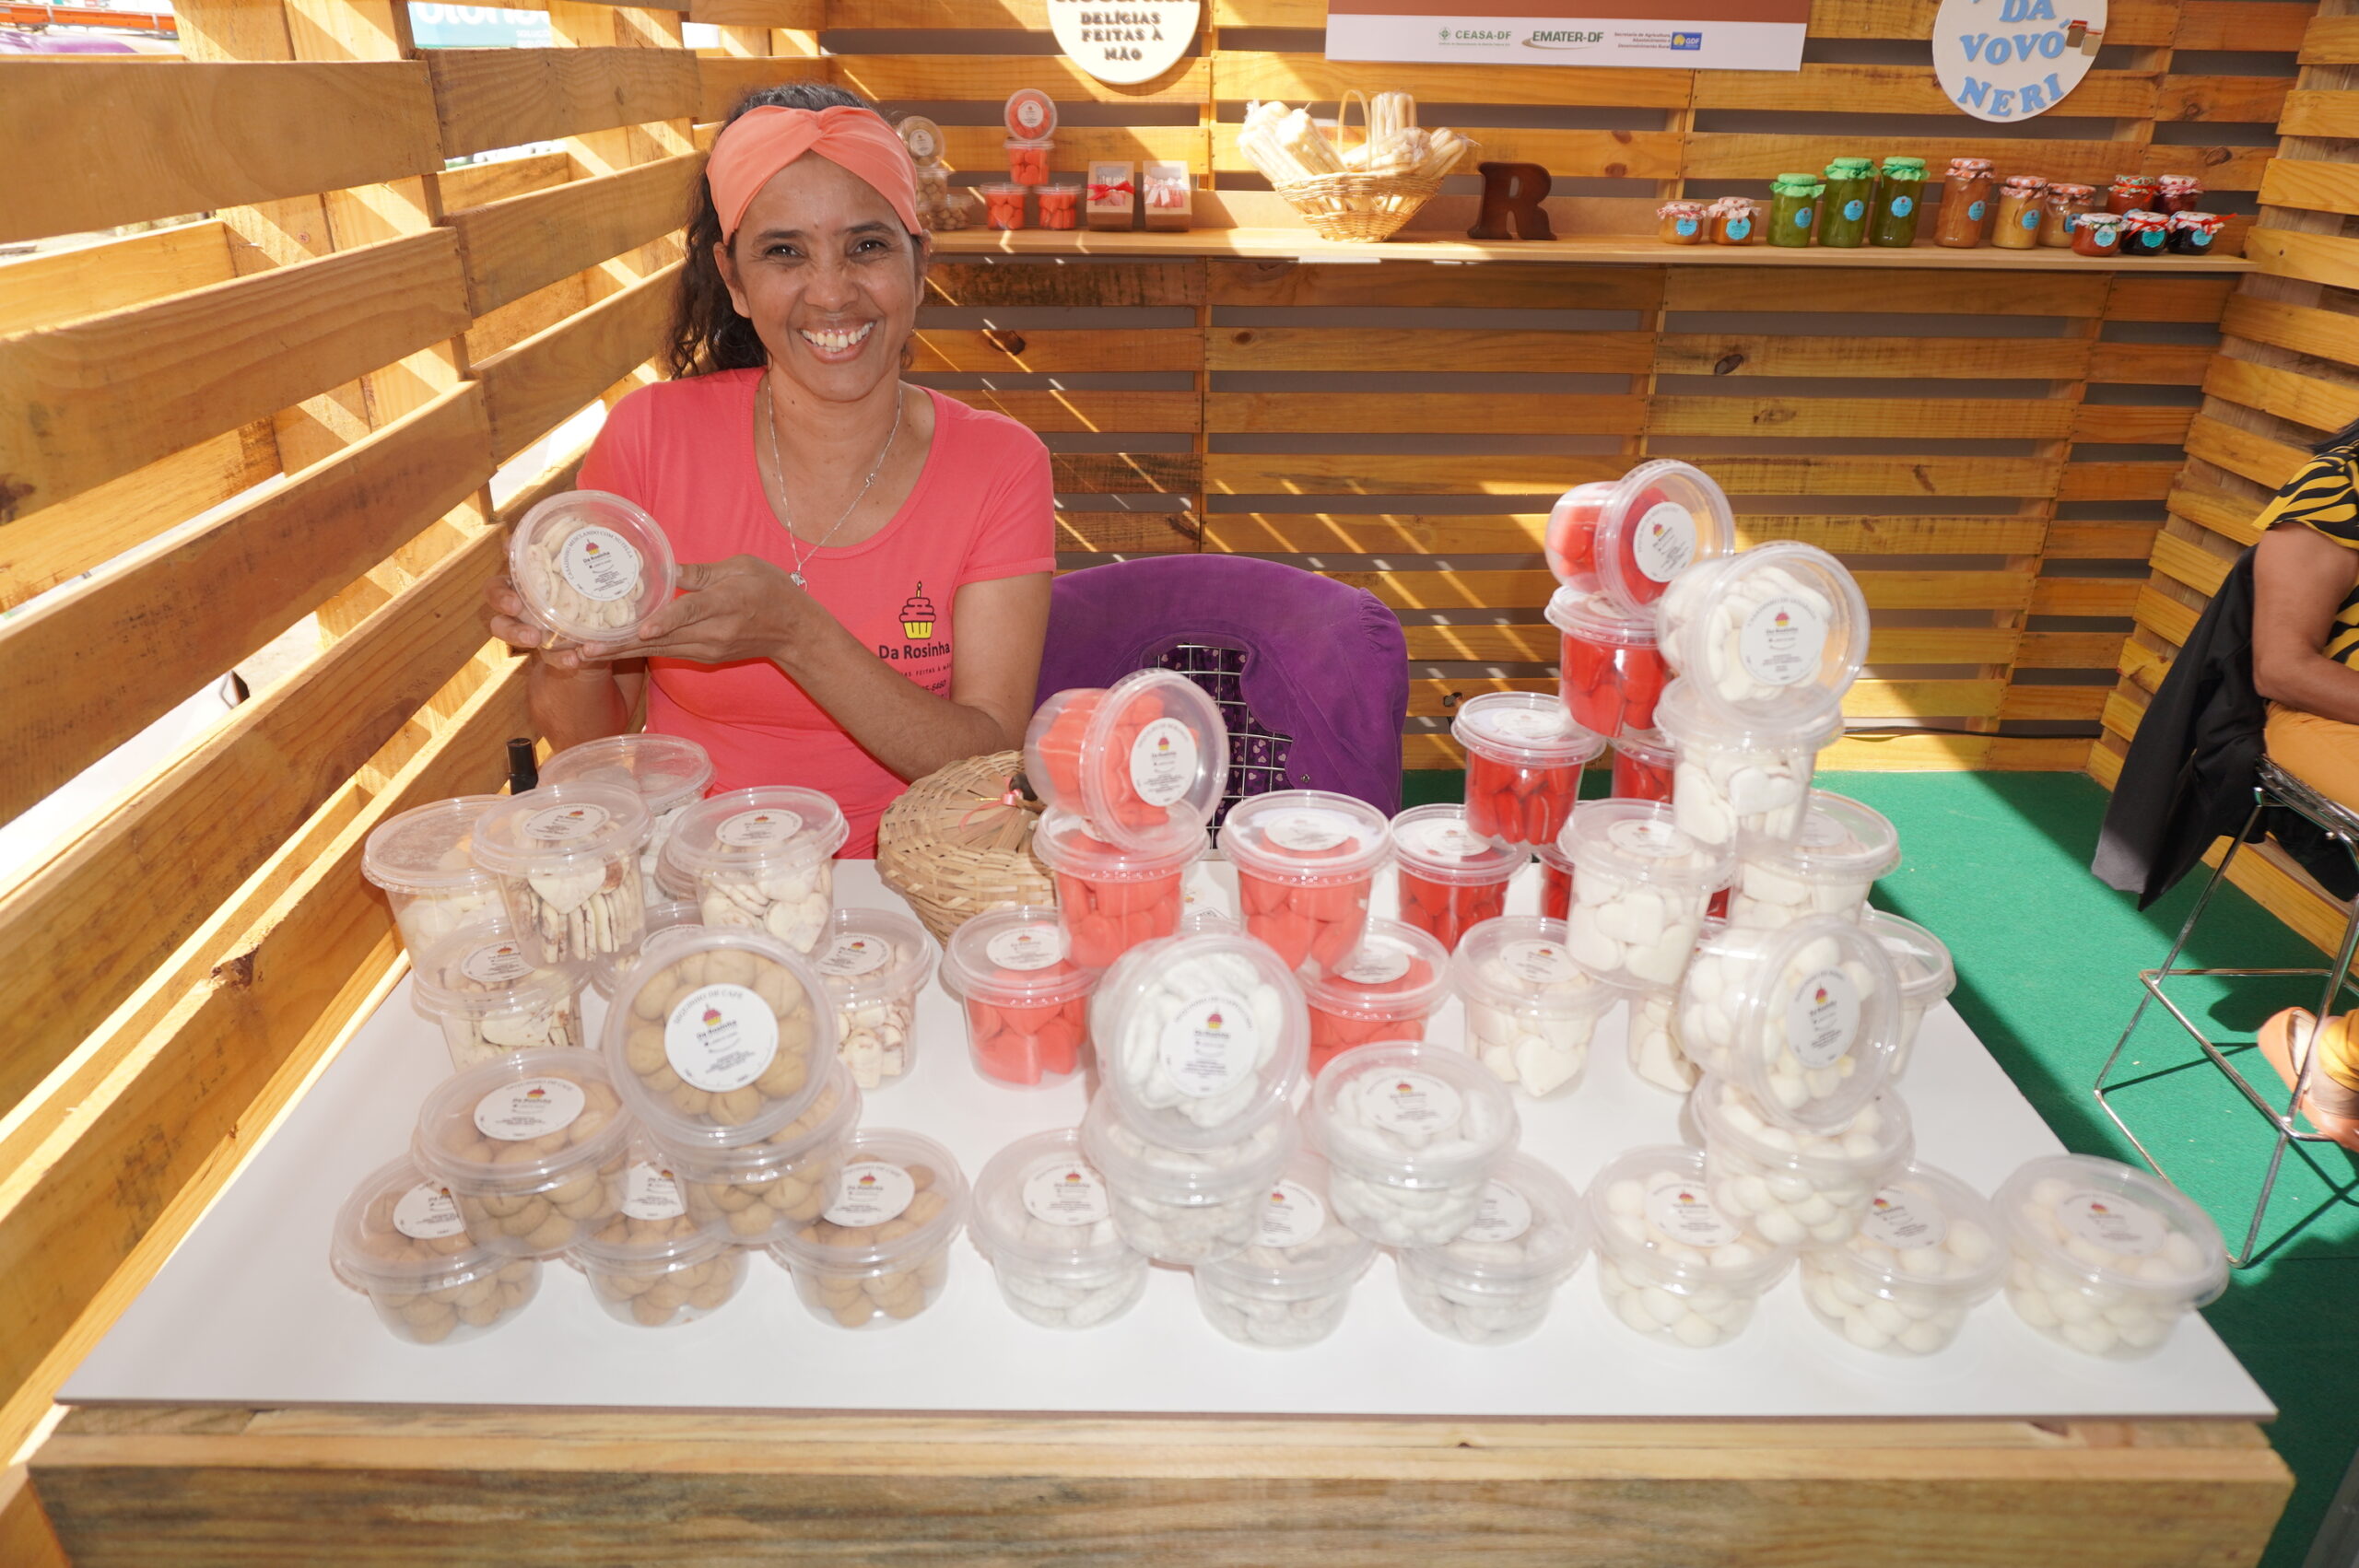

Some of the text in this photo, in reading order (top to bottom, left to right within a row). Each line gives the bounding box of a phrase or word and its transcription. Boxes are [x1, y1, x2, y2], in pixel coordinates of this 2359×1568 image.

[1080, 10, 1162, 25] DELÍCIAS
[1999, 0, 2057, 23] DA
[1081, 29, 1145, 41] FEITAS
[1455, 29, 1512, 41] CEASA-DF
[1532, 30, 1604, 43] EMATER-DF
[1959, 18, 2071, 65] VOVÓ
[1105, 46, 1143, 61] MÃO
[1957, 73, 2065, 117] NERI
[1467, 162, 1557, 240] R
[878, 641, 951, 660] Da Rosinha
